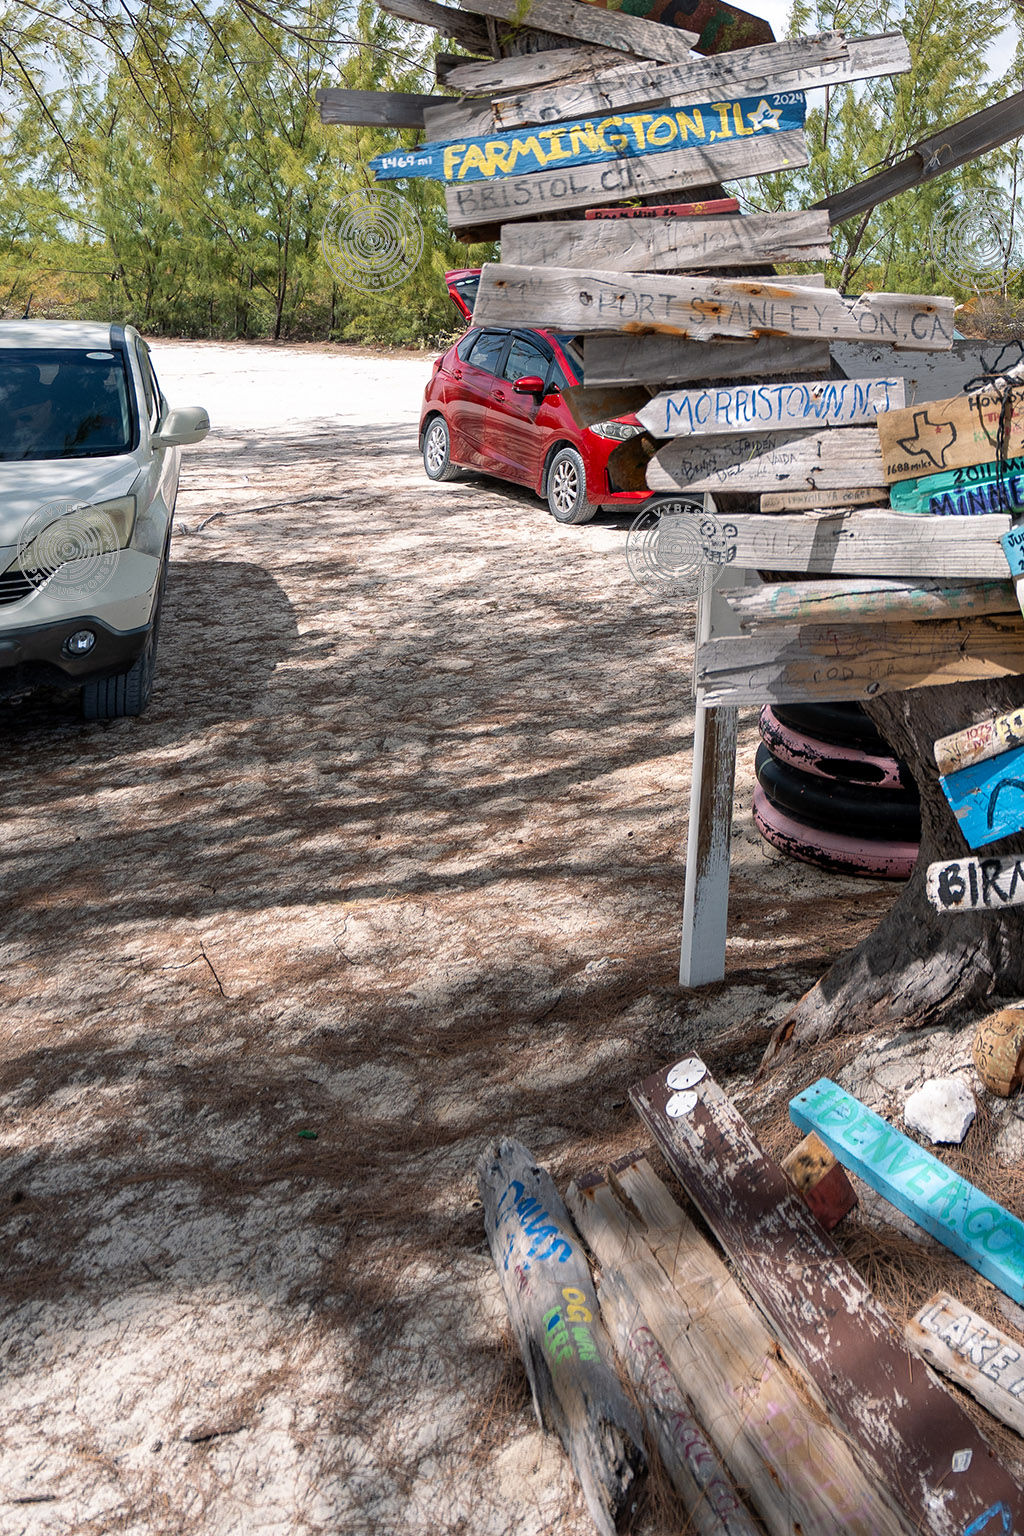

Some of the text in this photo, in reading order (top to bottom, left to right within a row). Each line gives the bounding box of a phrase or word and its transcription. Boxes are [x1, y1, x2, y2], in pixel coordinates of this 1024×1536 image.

[773, 93, 804, 106] 2024
[717, 101, 754, 138] IL
[599, 292, 677, 321] PORT
[911, 312, 953, 342] CA
[952, 468, 992, 485] 2011
[919, 1297, 1021, 1384] LAKE
